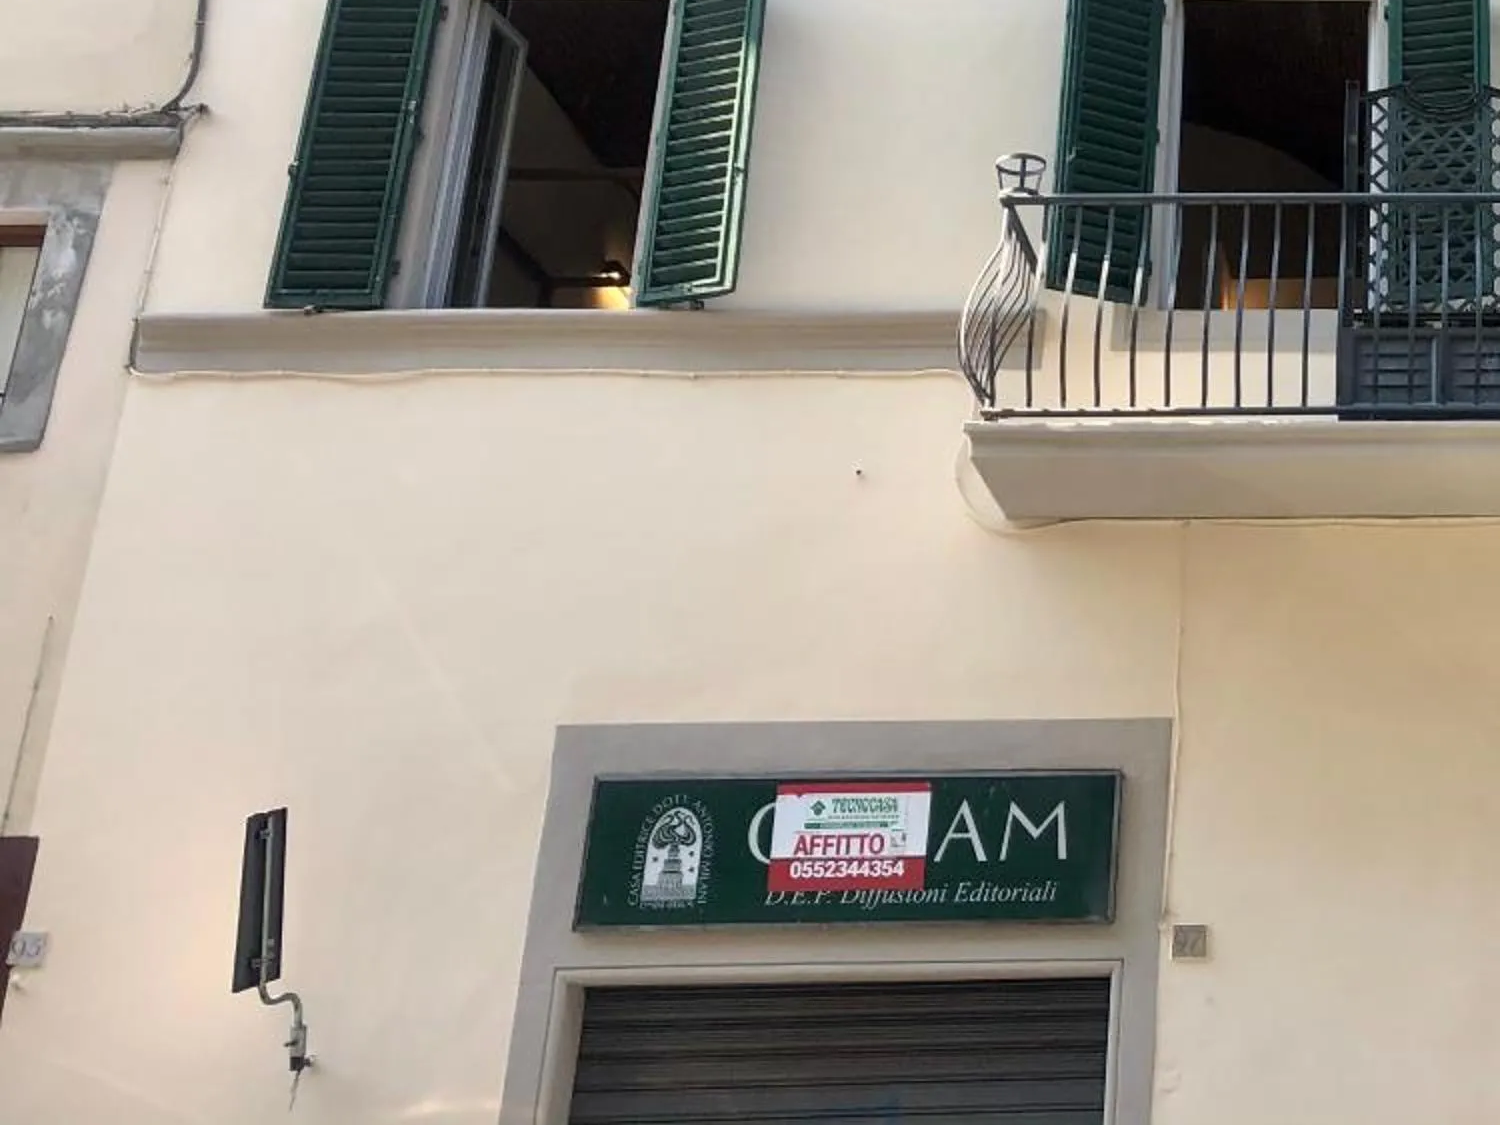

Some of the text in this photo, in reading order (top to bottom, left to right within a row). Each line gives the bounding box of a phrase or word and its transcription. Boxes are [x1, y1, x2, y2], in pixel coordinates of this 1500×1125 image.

[793, 833, 885, 856] AFFITTO
[789, 860, 905, 879] 0552344354
[954, 881, 1057, 903] Editoriali
